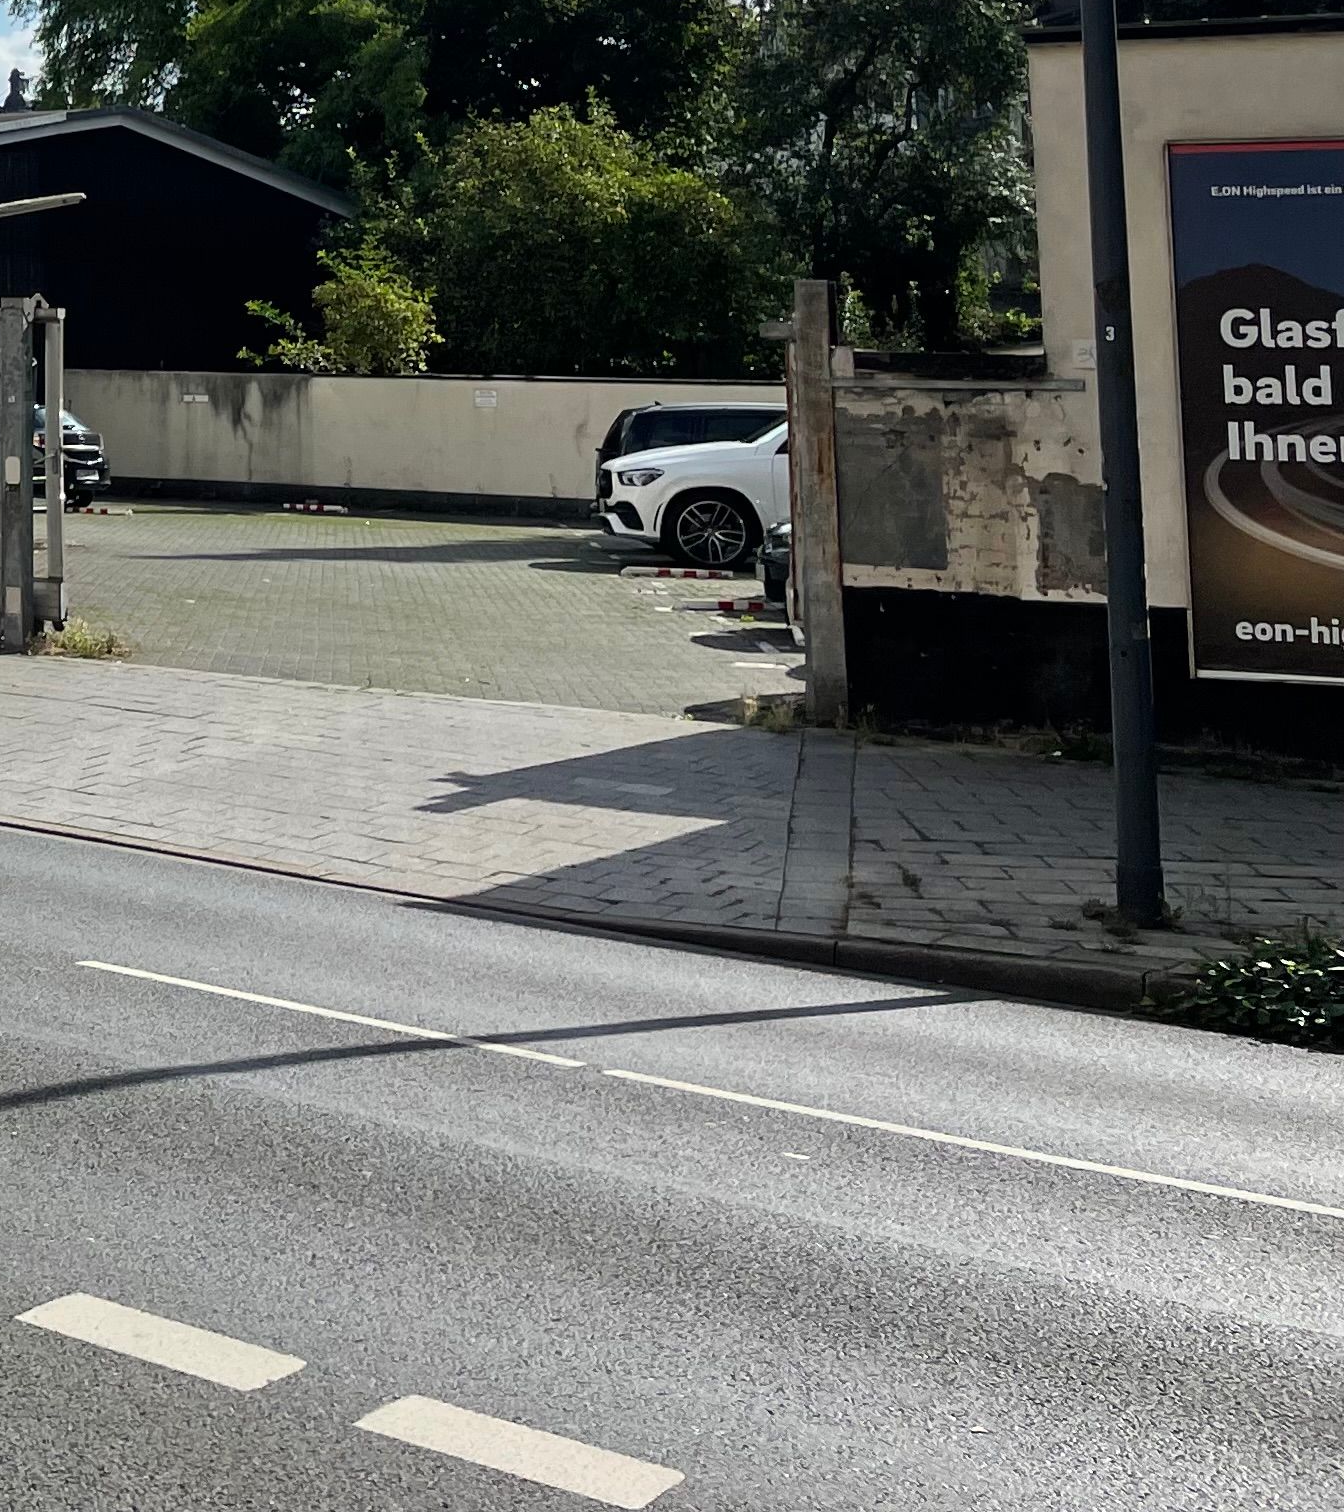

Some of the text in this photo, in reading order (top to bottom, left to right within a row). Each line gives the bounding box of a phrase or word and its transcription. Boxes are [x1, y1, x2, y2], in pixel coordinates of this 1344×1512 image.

[1211, 184, 1343, 198] E.ON Highspeed ist ein
[1105, 326, 1115, 341] 3
[1223, 364, 1333, 405] bald
[1227, 421, 1344, 463] Ihne
[1235, 616, 1344, 650] eon-hi
